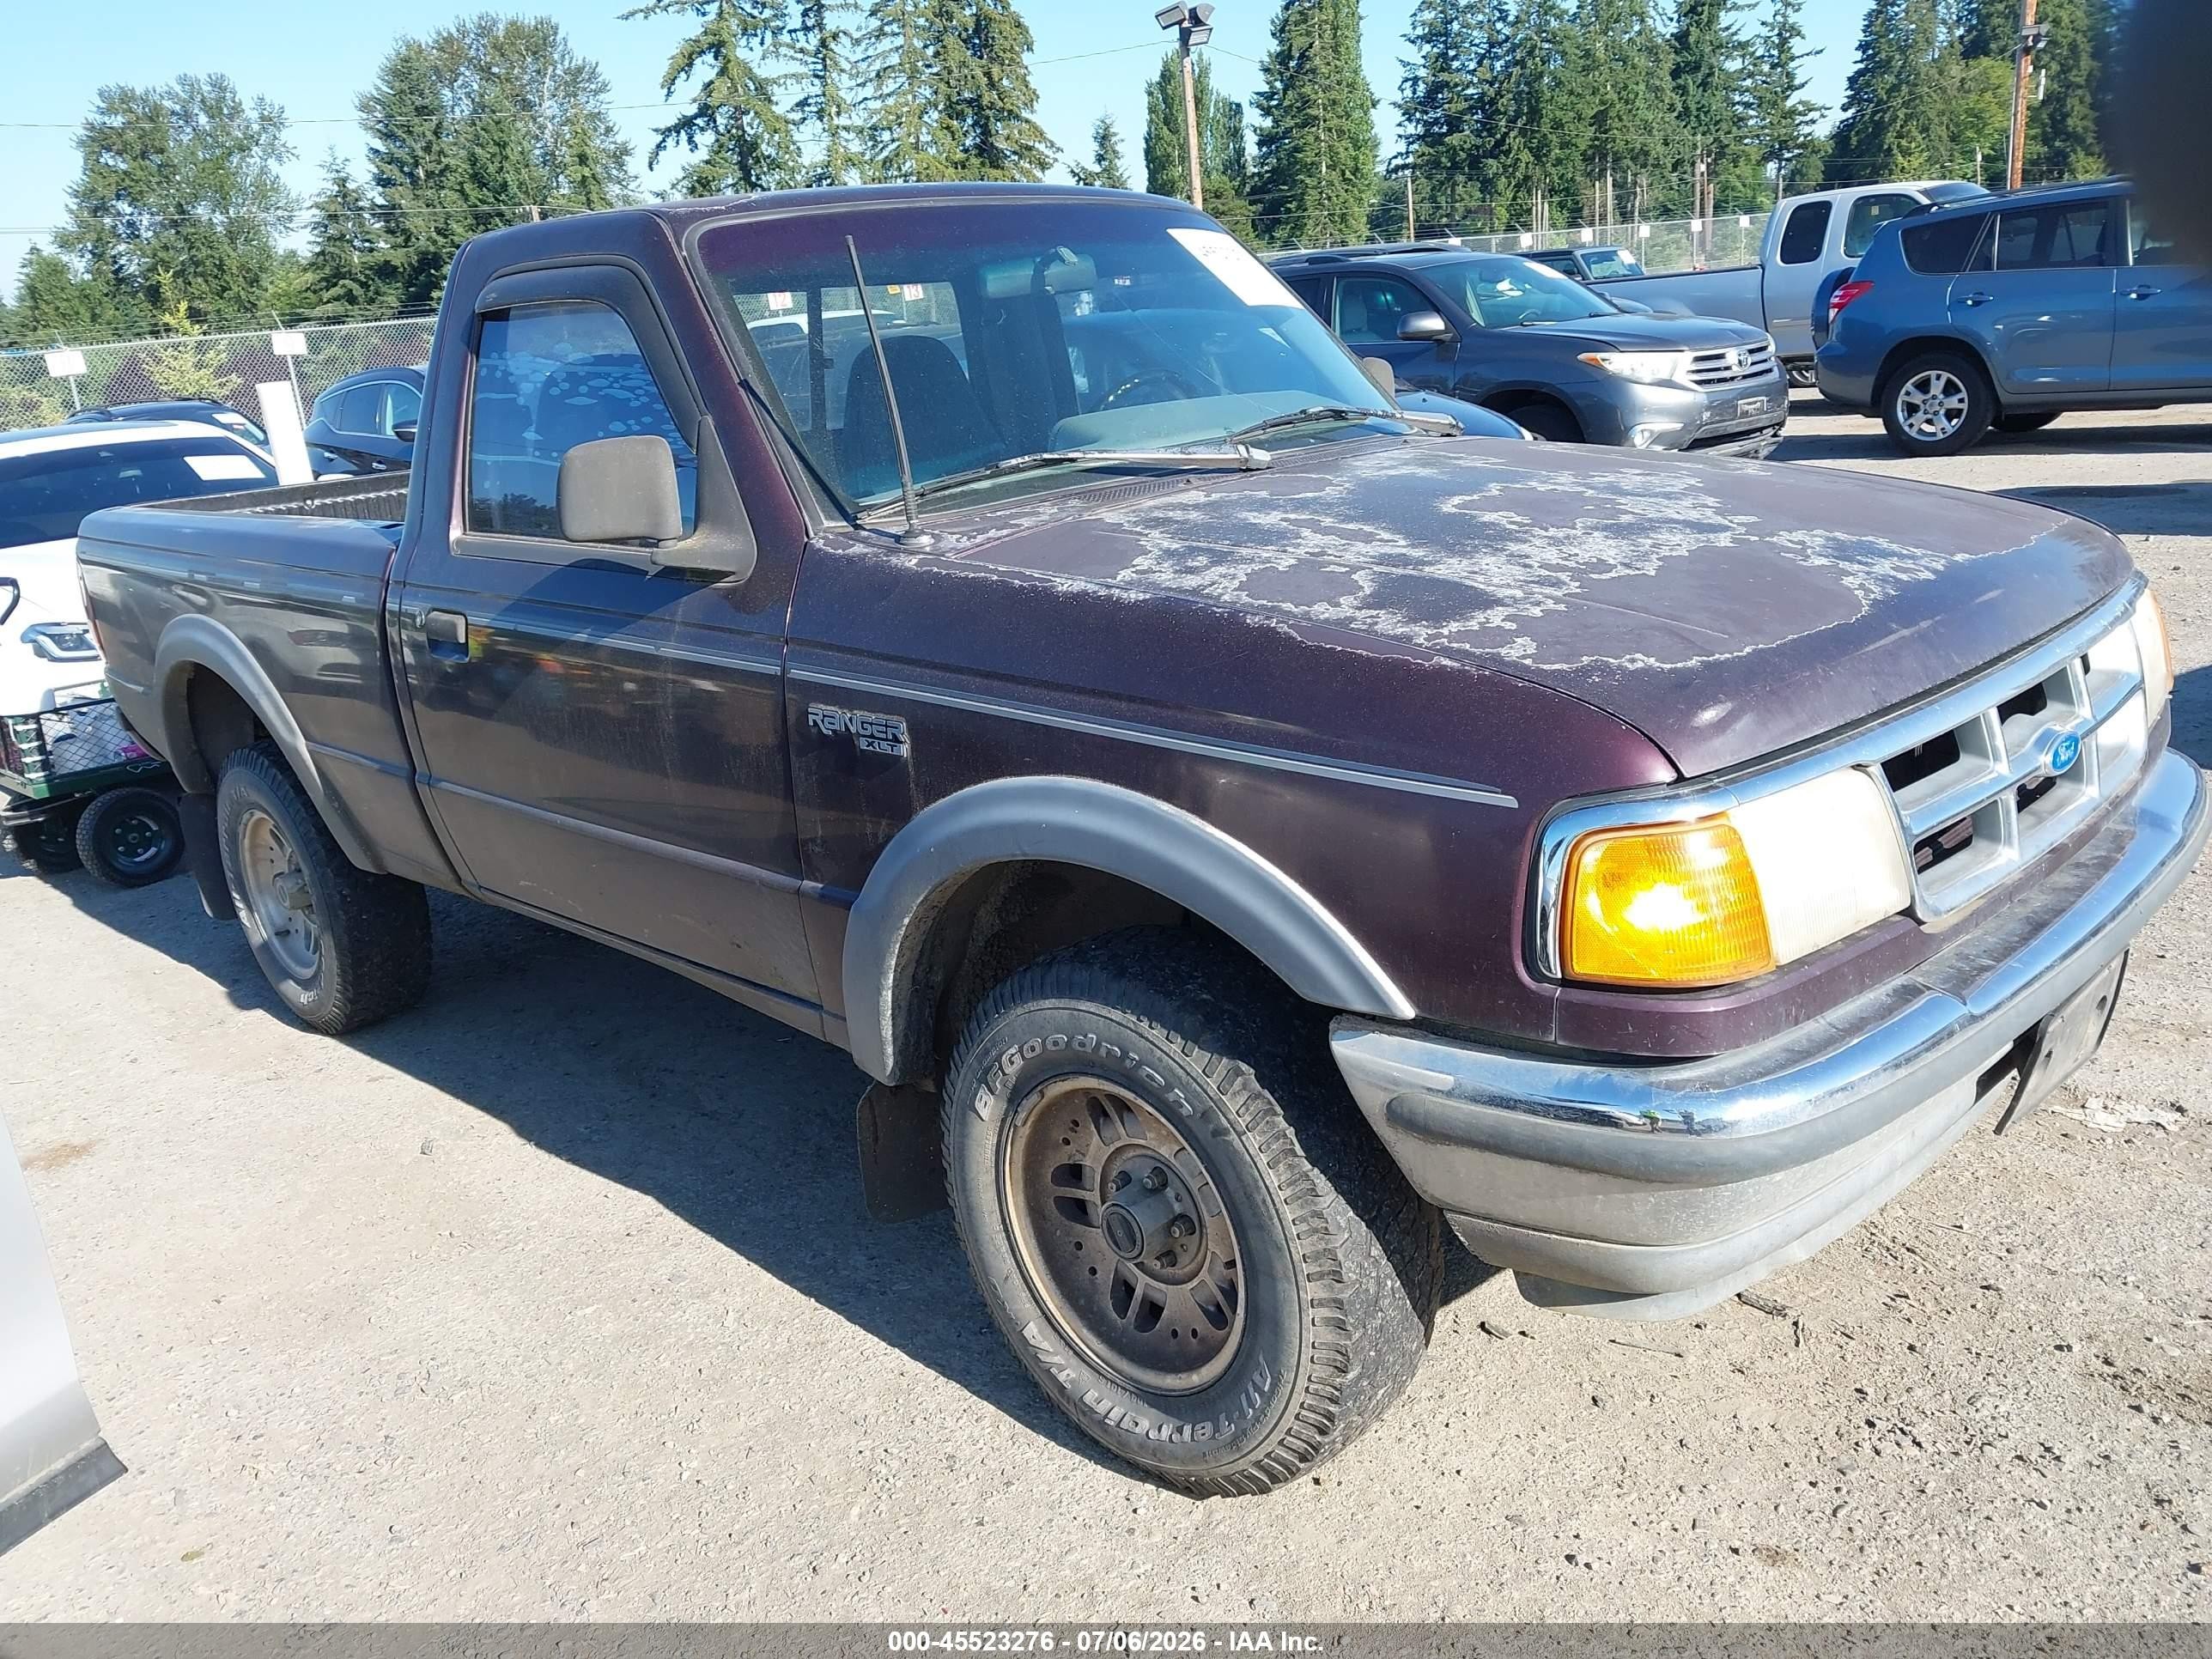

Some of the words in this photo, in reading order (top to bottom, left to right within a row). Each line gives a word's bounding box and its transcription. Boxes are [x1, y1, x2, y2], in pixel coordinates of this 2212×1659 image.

[807, 706, 908, 743] RANGER
[865, 739, 898, 753] XLT
[975, 1033, 1194, 1121] BFGoodrich
[1021, 1321, 1076, 1389] T/A
